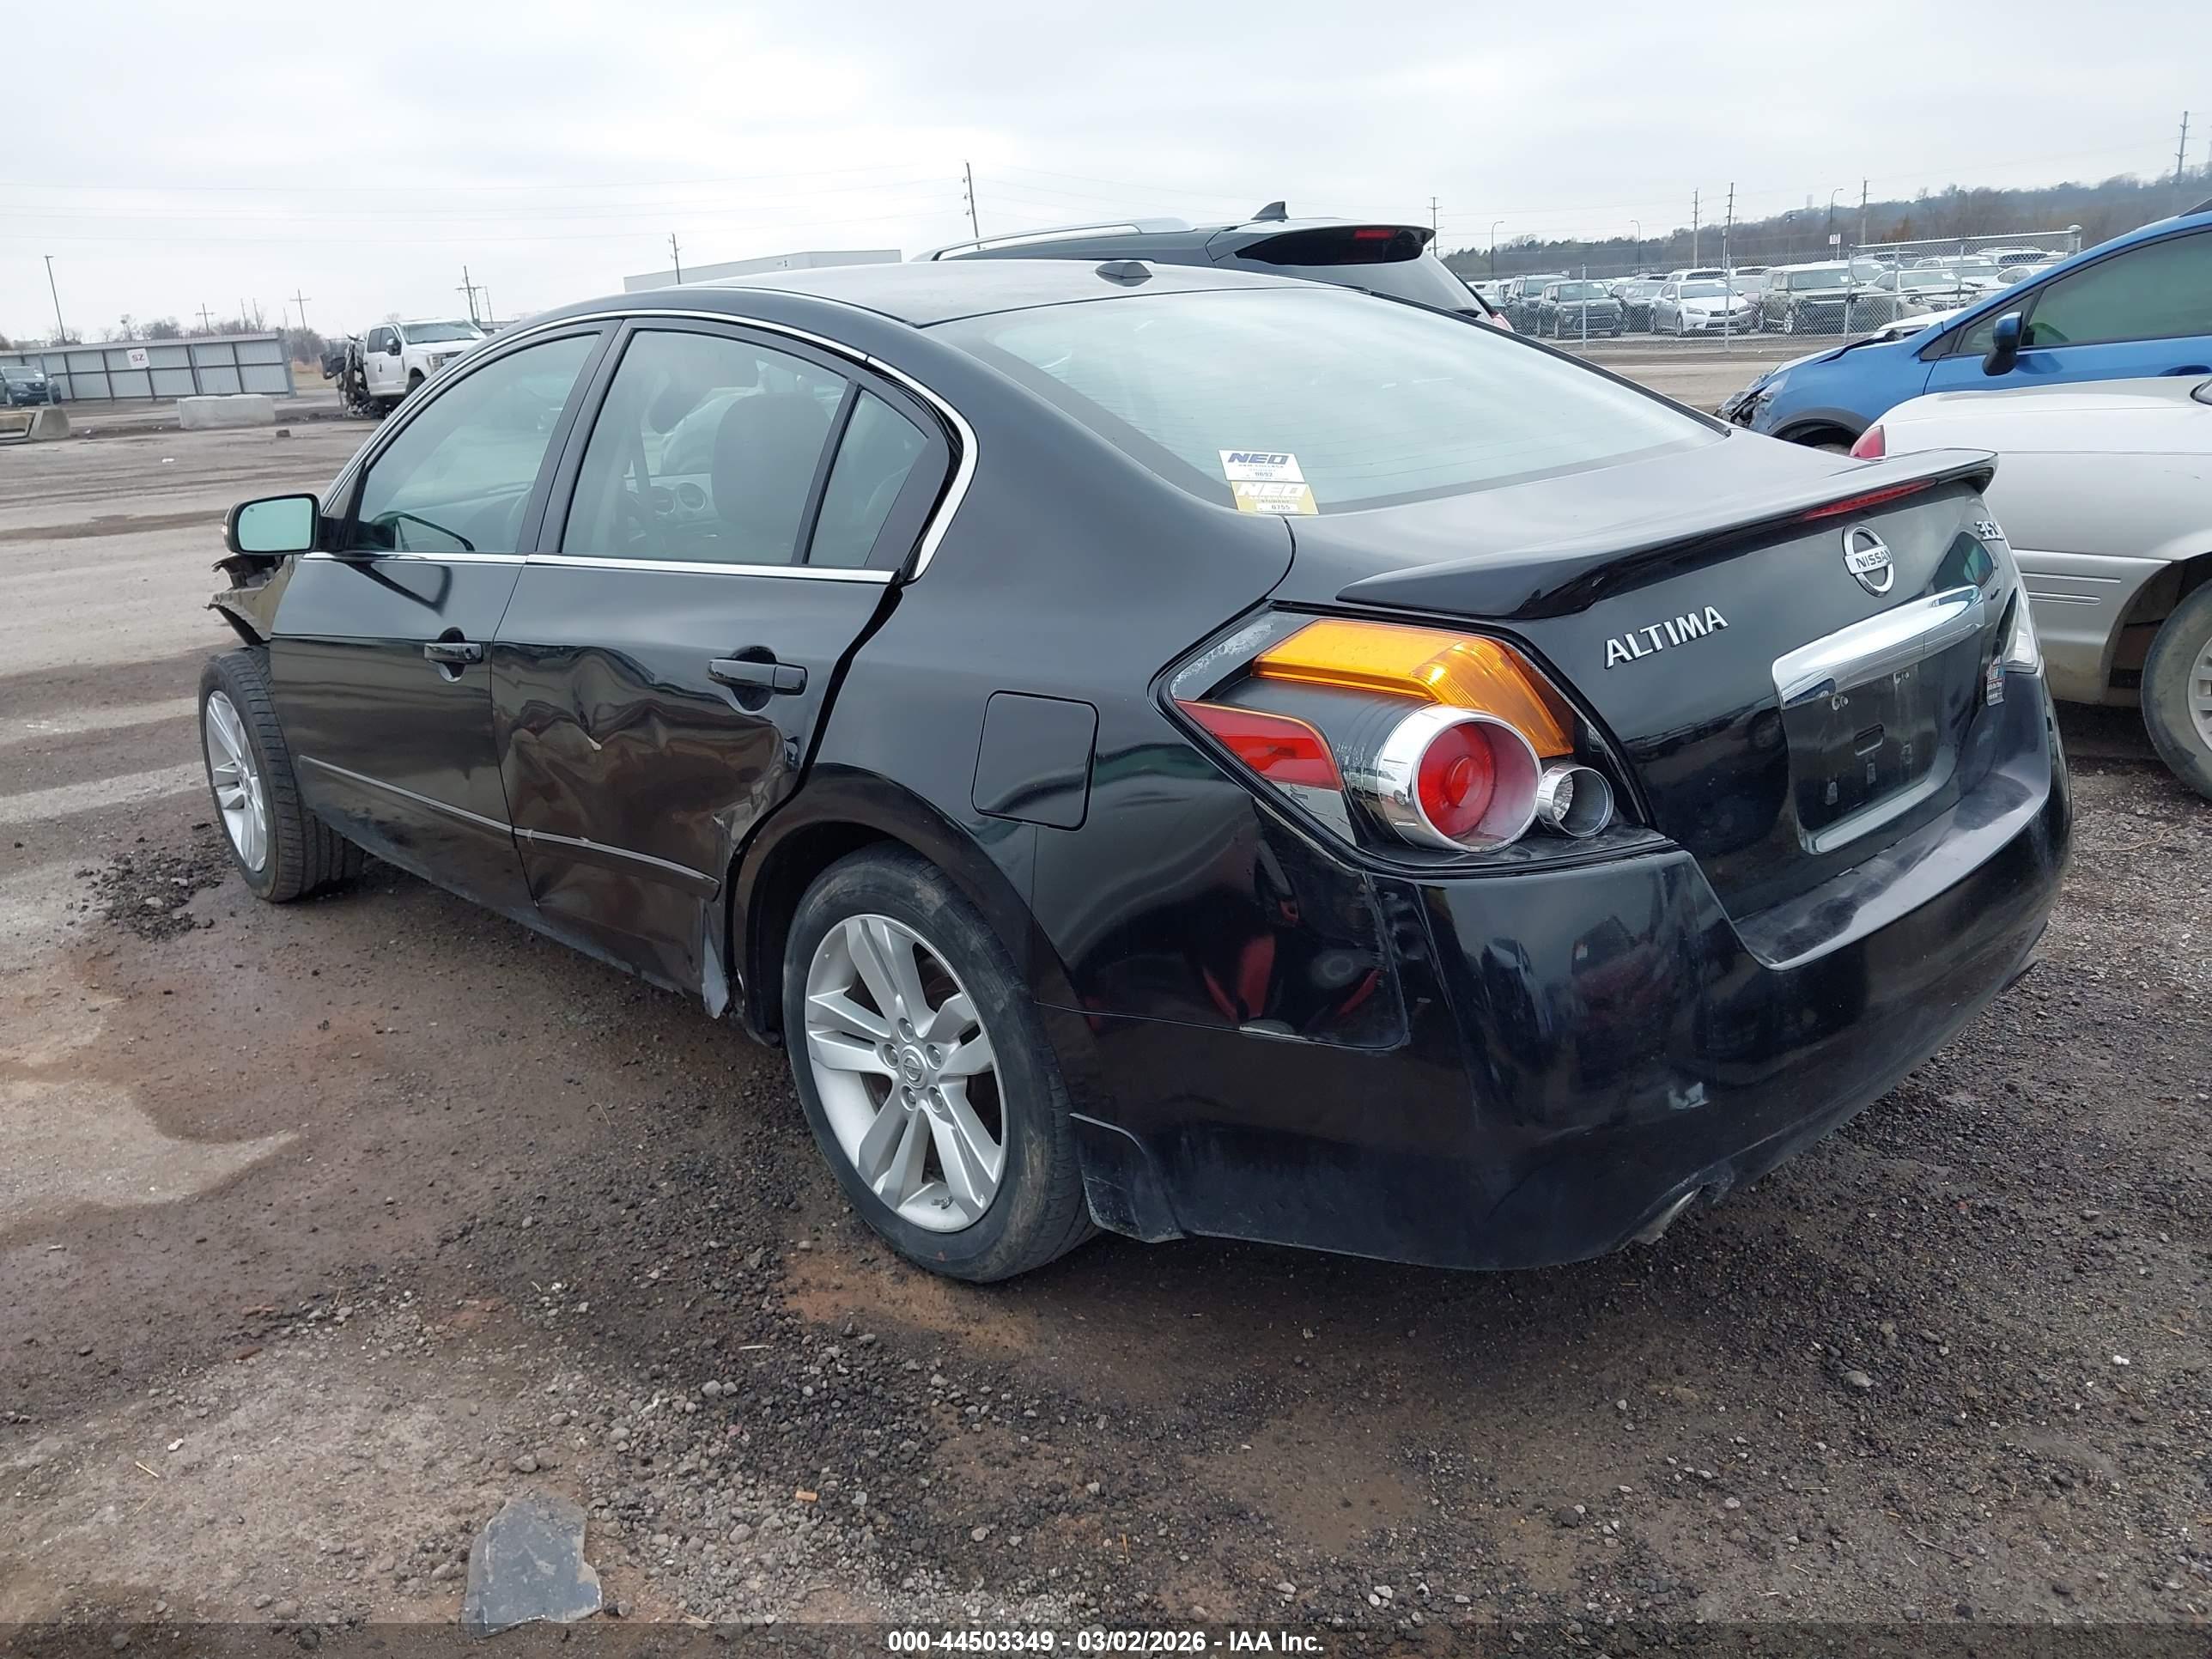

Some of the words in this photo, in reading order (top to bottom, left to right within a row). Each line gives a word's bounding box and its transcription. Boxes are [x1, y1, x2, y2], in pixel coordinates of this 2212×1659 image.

[1228, 453, 1290, 465] NEO
[1855, 549, 1892, 569] NISSAN
[1605, 605, 1729, 669] ALTIMA
